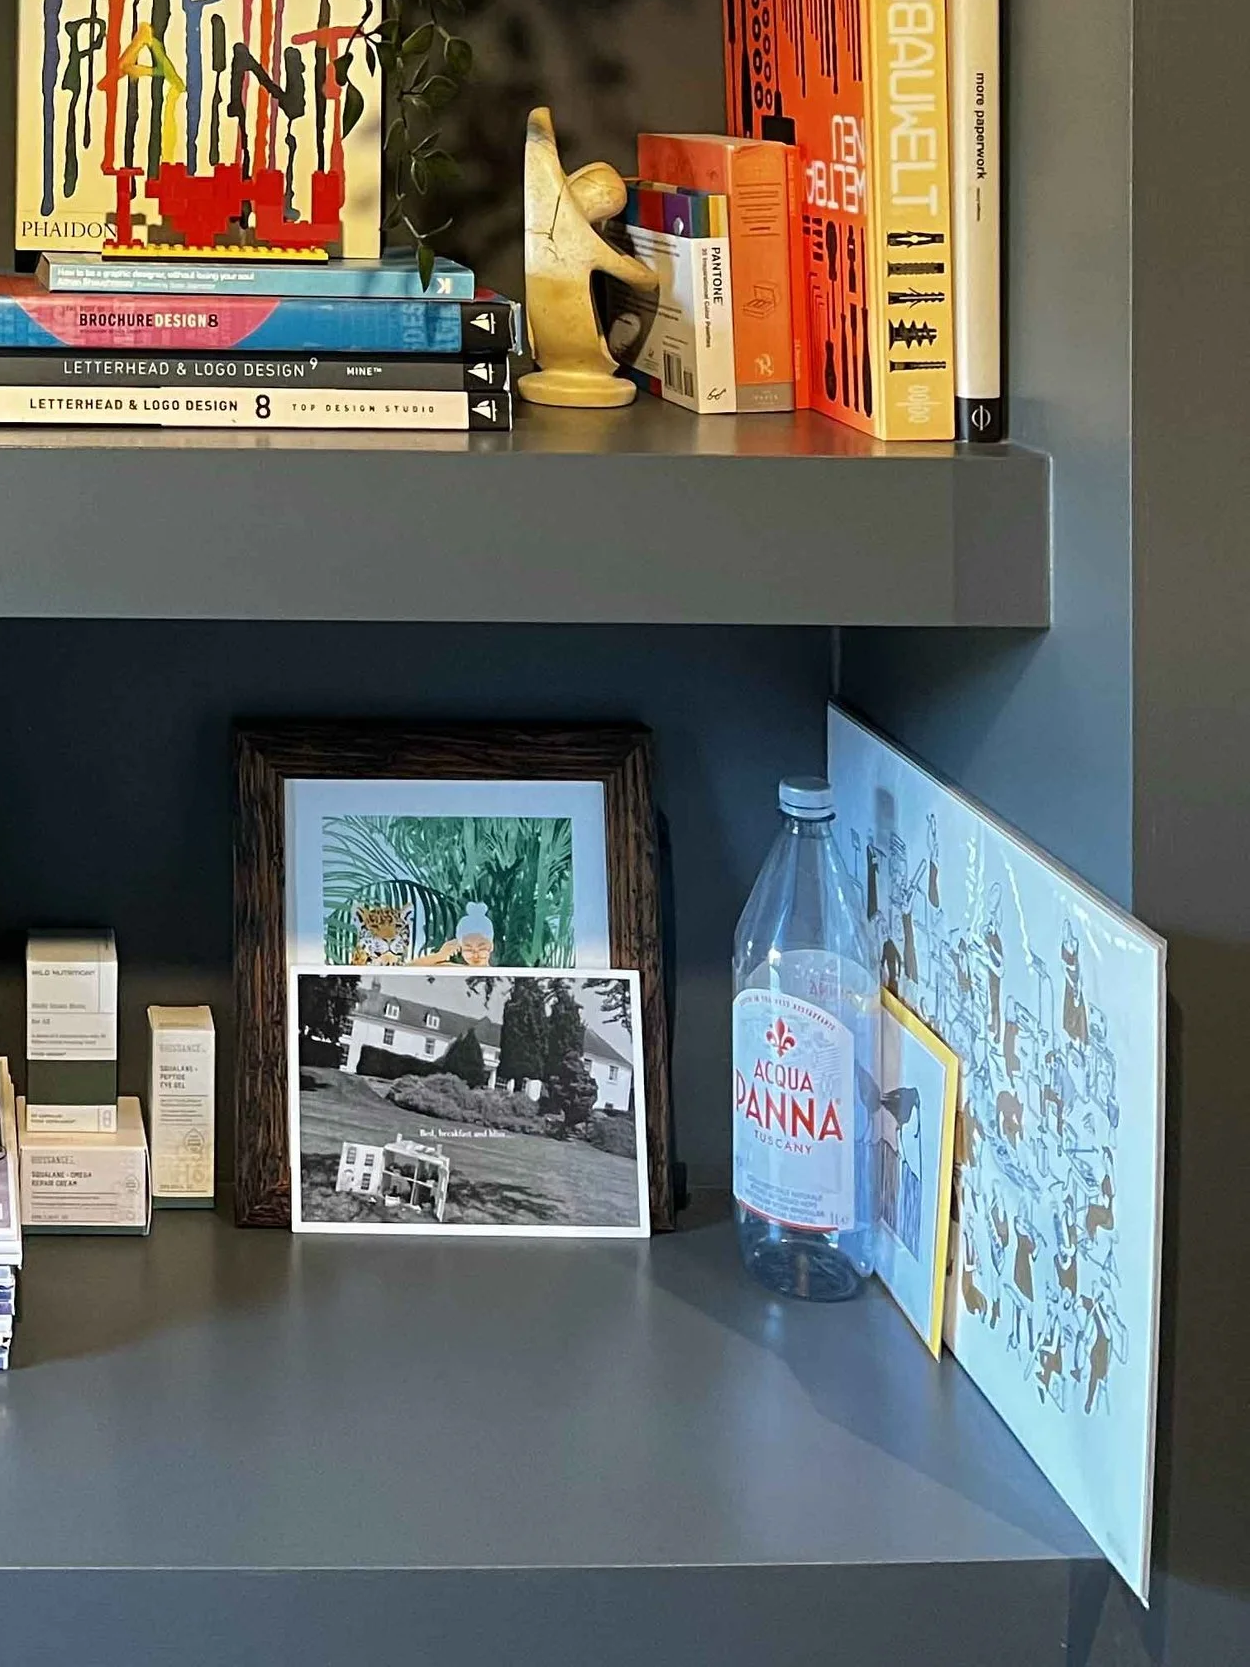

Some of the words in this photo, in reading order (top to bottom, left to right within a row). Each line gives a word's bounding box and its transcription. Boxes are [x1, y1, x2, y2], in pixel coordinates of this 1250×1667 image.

[975, 72, 985, 106] more
[973, 110, 986, 180] paperwork
[21, 220, 118, 239] PHAIDON
[102, 269, 132, 281] graphic
[711, 246, 723, 305] PANTONE
[63, 359, 170, 376] LETTERHEAD
[176, 361, 187, 376] &
[195, 362, 238, 377] LOGO
[244, 362, 306, 378] DESIGN
[309, 356, 319, 371] 9
[30, 397, 124, 411] LETTERHEAD
[128, 398, 138, 411] &
[143, 399, 180, 412] LOGO
[185, 399, 238, 412] DESIGN
[254, 394, 272, 420] 8
[292, 403, 316, 412] TOP
[325, 404, 376, 413] DESIGN
[385, 404, 435, 414] STUDIO
[753, 1058, 814, 1094] ACQUA
[735, 1068, 844, 1142] PANNA
[473, 1129, 488, 1138] and
[753, 1129, 812, 1155] TUSCANY
